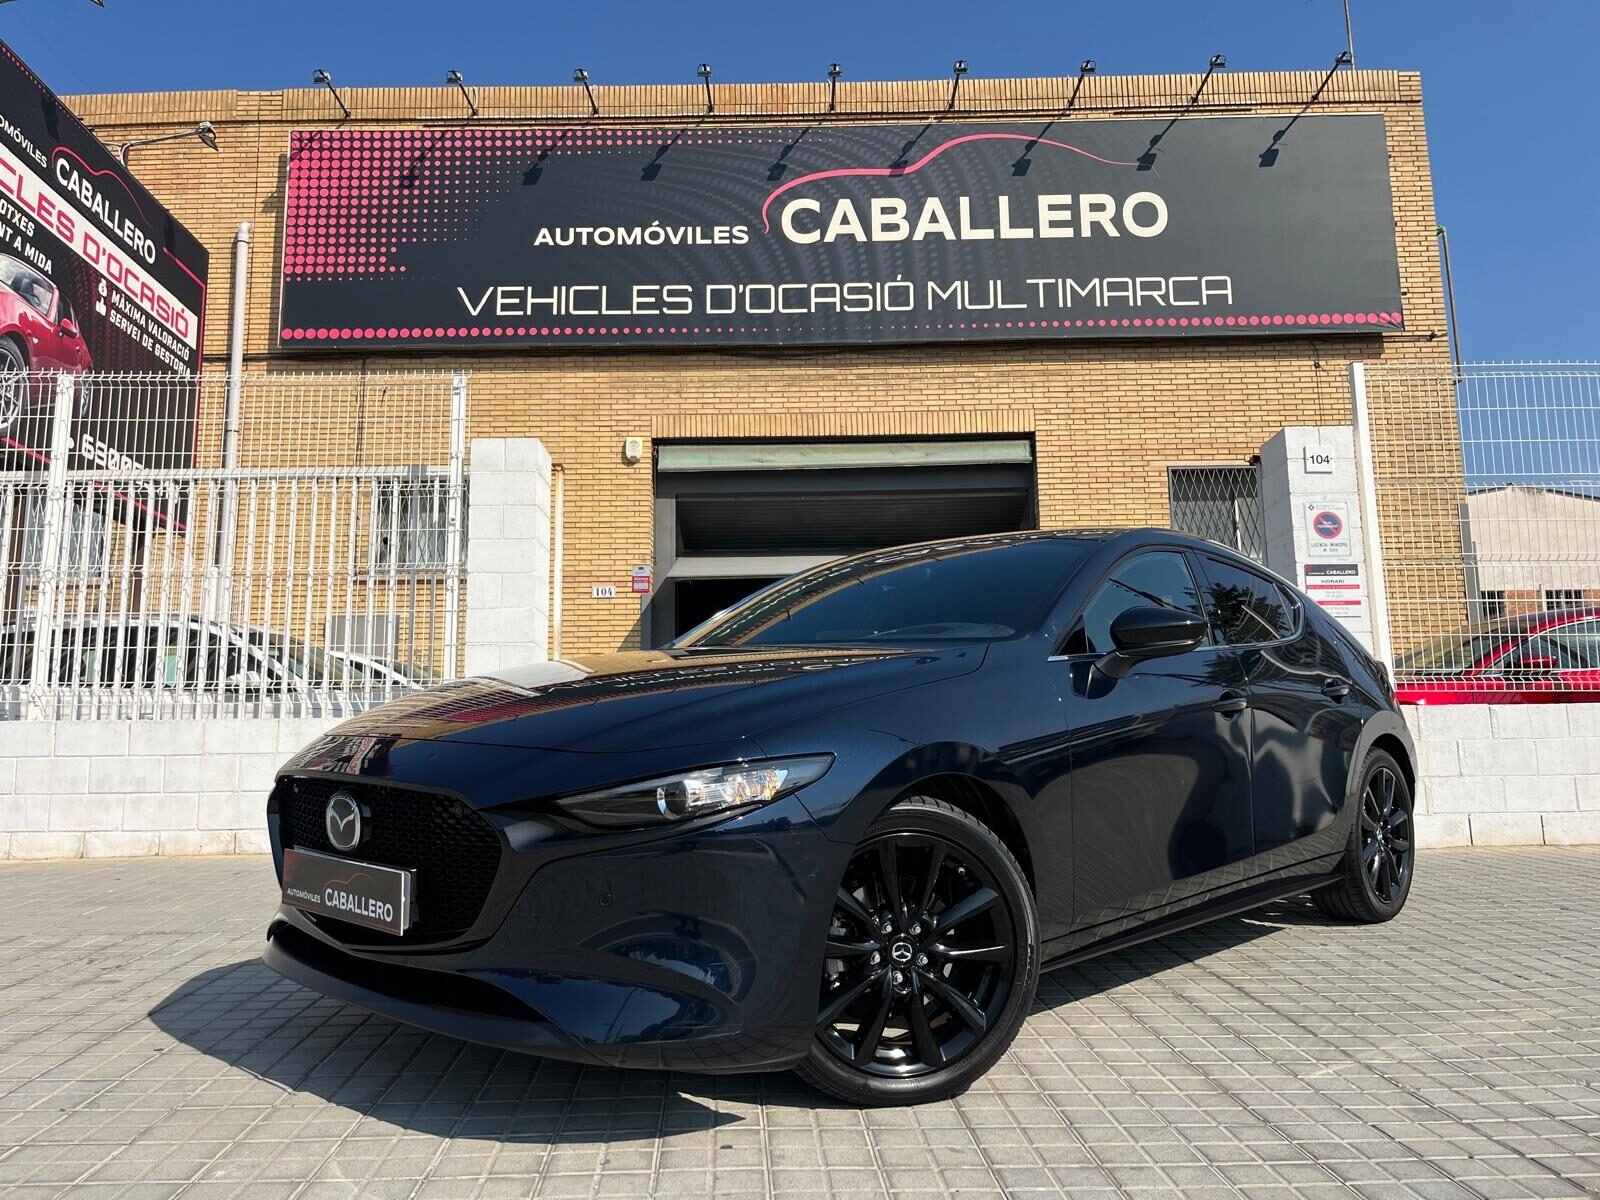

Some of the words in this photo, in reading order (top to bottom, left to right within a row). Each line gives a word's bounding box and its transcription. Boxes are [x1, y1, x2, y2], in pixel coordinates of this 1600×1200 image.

[56, 157, 156, 265] CABALLERO
[533, 220, 749, 246] AUTOMÓVILES
[780, 191, 1169, 245] CABALLERO
[13, 236, 22, 252] A
[24, 242, 52, 275] MIDA
[83, 231, 189, 338] D'OCASIÓ
[456, 285, 693, 316] VEHICLES
[706, 274, 914, 315] D'OCASIÓ
[927, 276, 1234, 312] MULTIMARCA
[109, 309, 141, 342] SERVEI
[142, 334, 153, 351] DE
[111, 290, 146, 328] MÀXIMA
[148, 319, 190, 361] VALORACIÓ
[1309, 454, 1330, 465] 104
[596, 587, 613, 597] 104
[286, 887, 321, 904] AUTOMÓVILES
[325, 888, 393, 922] CABALLERO
